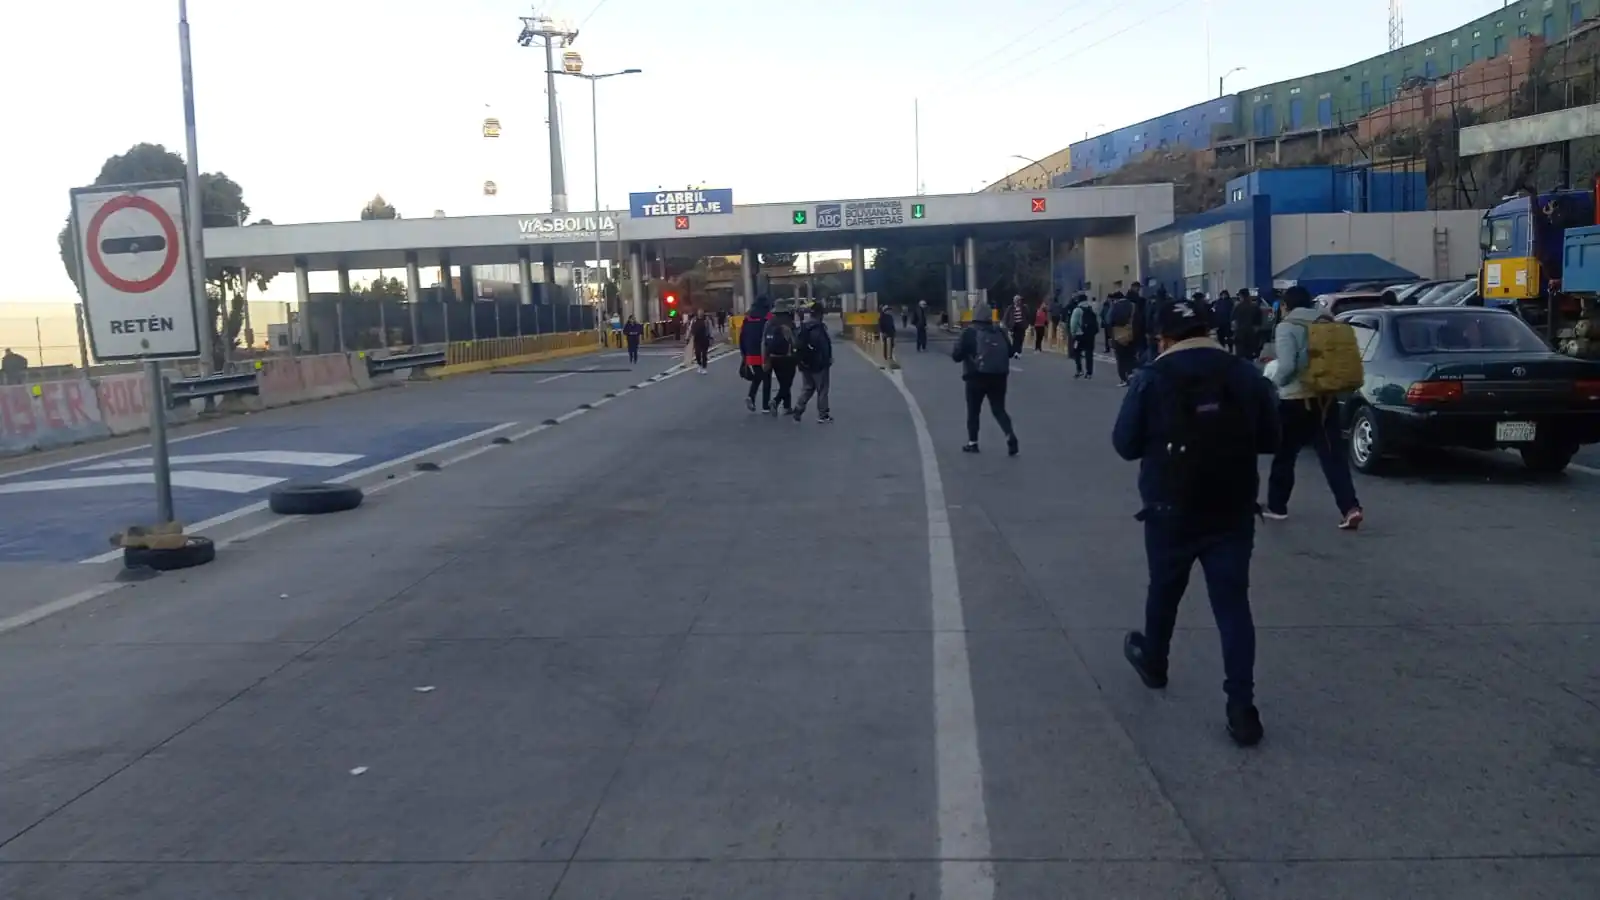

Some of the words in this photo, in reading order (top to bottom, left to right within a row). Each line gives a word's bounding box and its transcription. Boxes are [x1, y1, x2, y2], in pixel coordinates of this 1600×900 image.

[656, 191, 706, 204] CARRIL
[642, 202, 721, 216] TELEPEAJE
[846, 208, 890, 218] BOLIVIANA
[891, 207, 903, 215] DE
[817, 214, 841, 227] ABC
[846, 216, 903, 227] CARRETERAS
[110, 315, 174, 335] RETÉN
